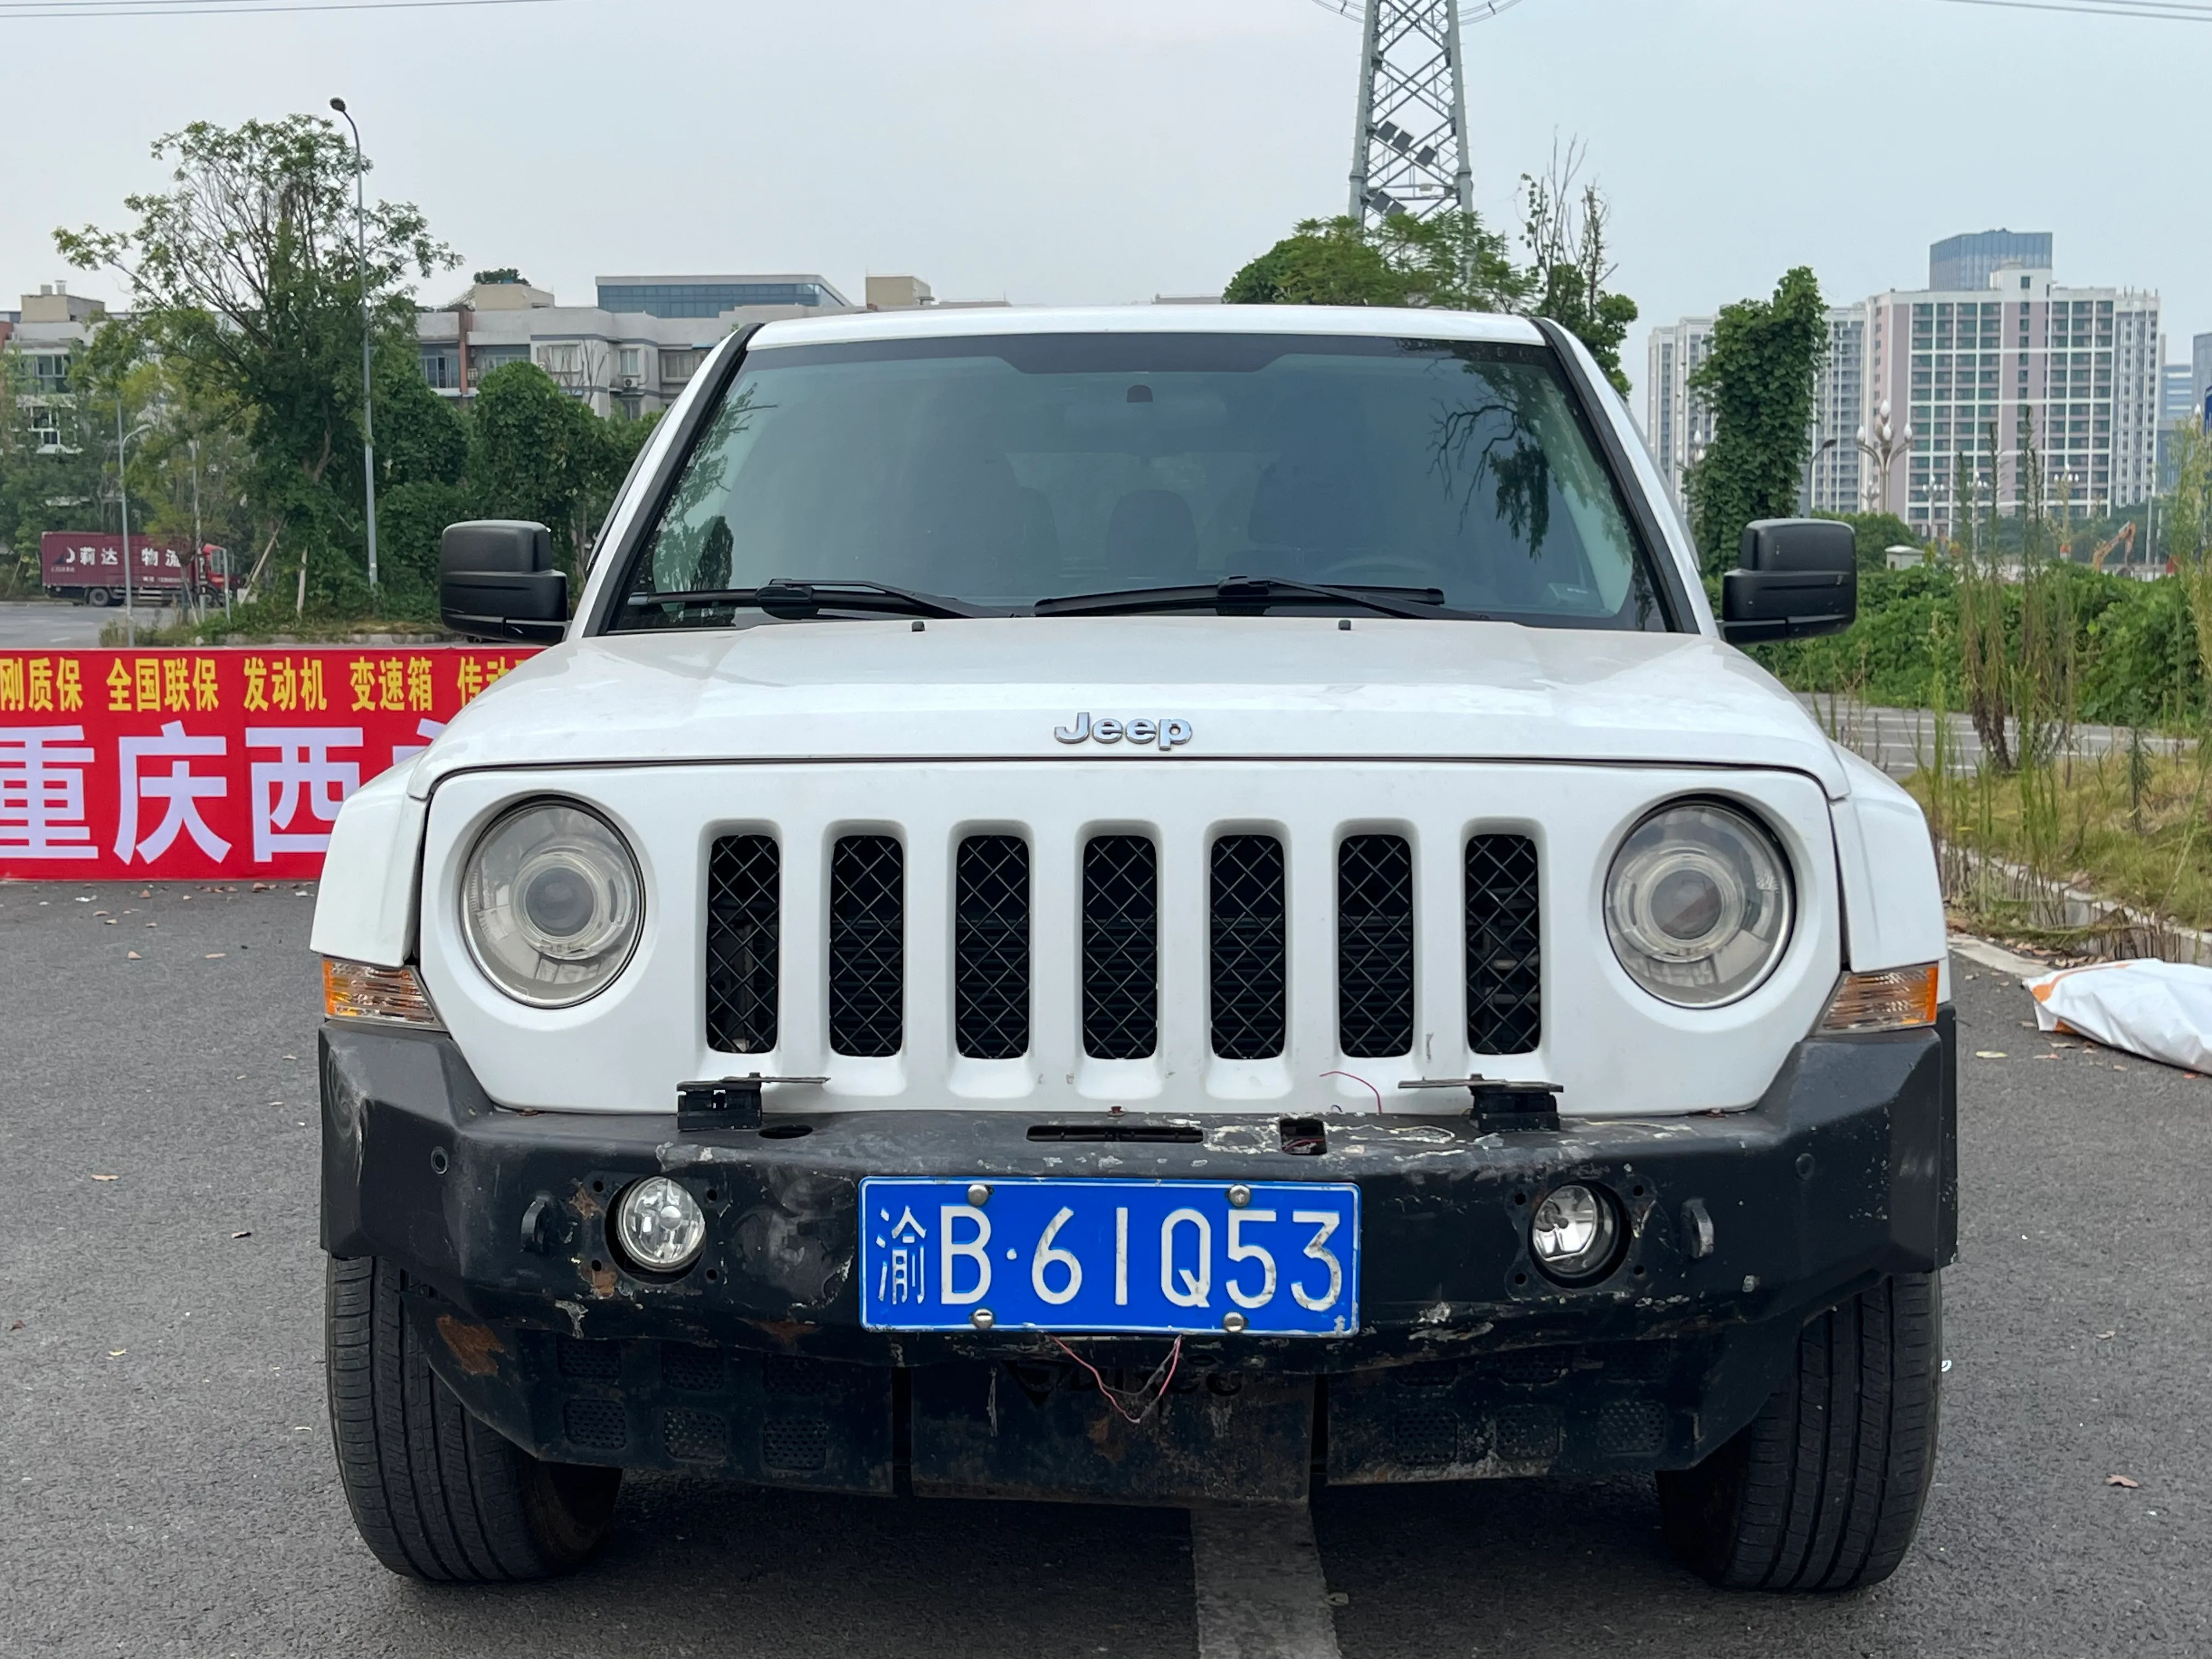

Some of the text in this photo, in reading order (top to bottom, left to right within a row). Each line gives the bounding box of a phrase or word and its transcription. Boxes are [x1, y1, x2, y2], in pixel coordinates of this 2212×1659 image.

[106, 657, 219, 712] 全国联保
[243, 657, 327, 712] 发动机
[350, 657, 433, 712] 变速箱
[1054, 712, 1193, 751] Jeep
[0, 719, 448, 865] 重庆西
